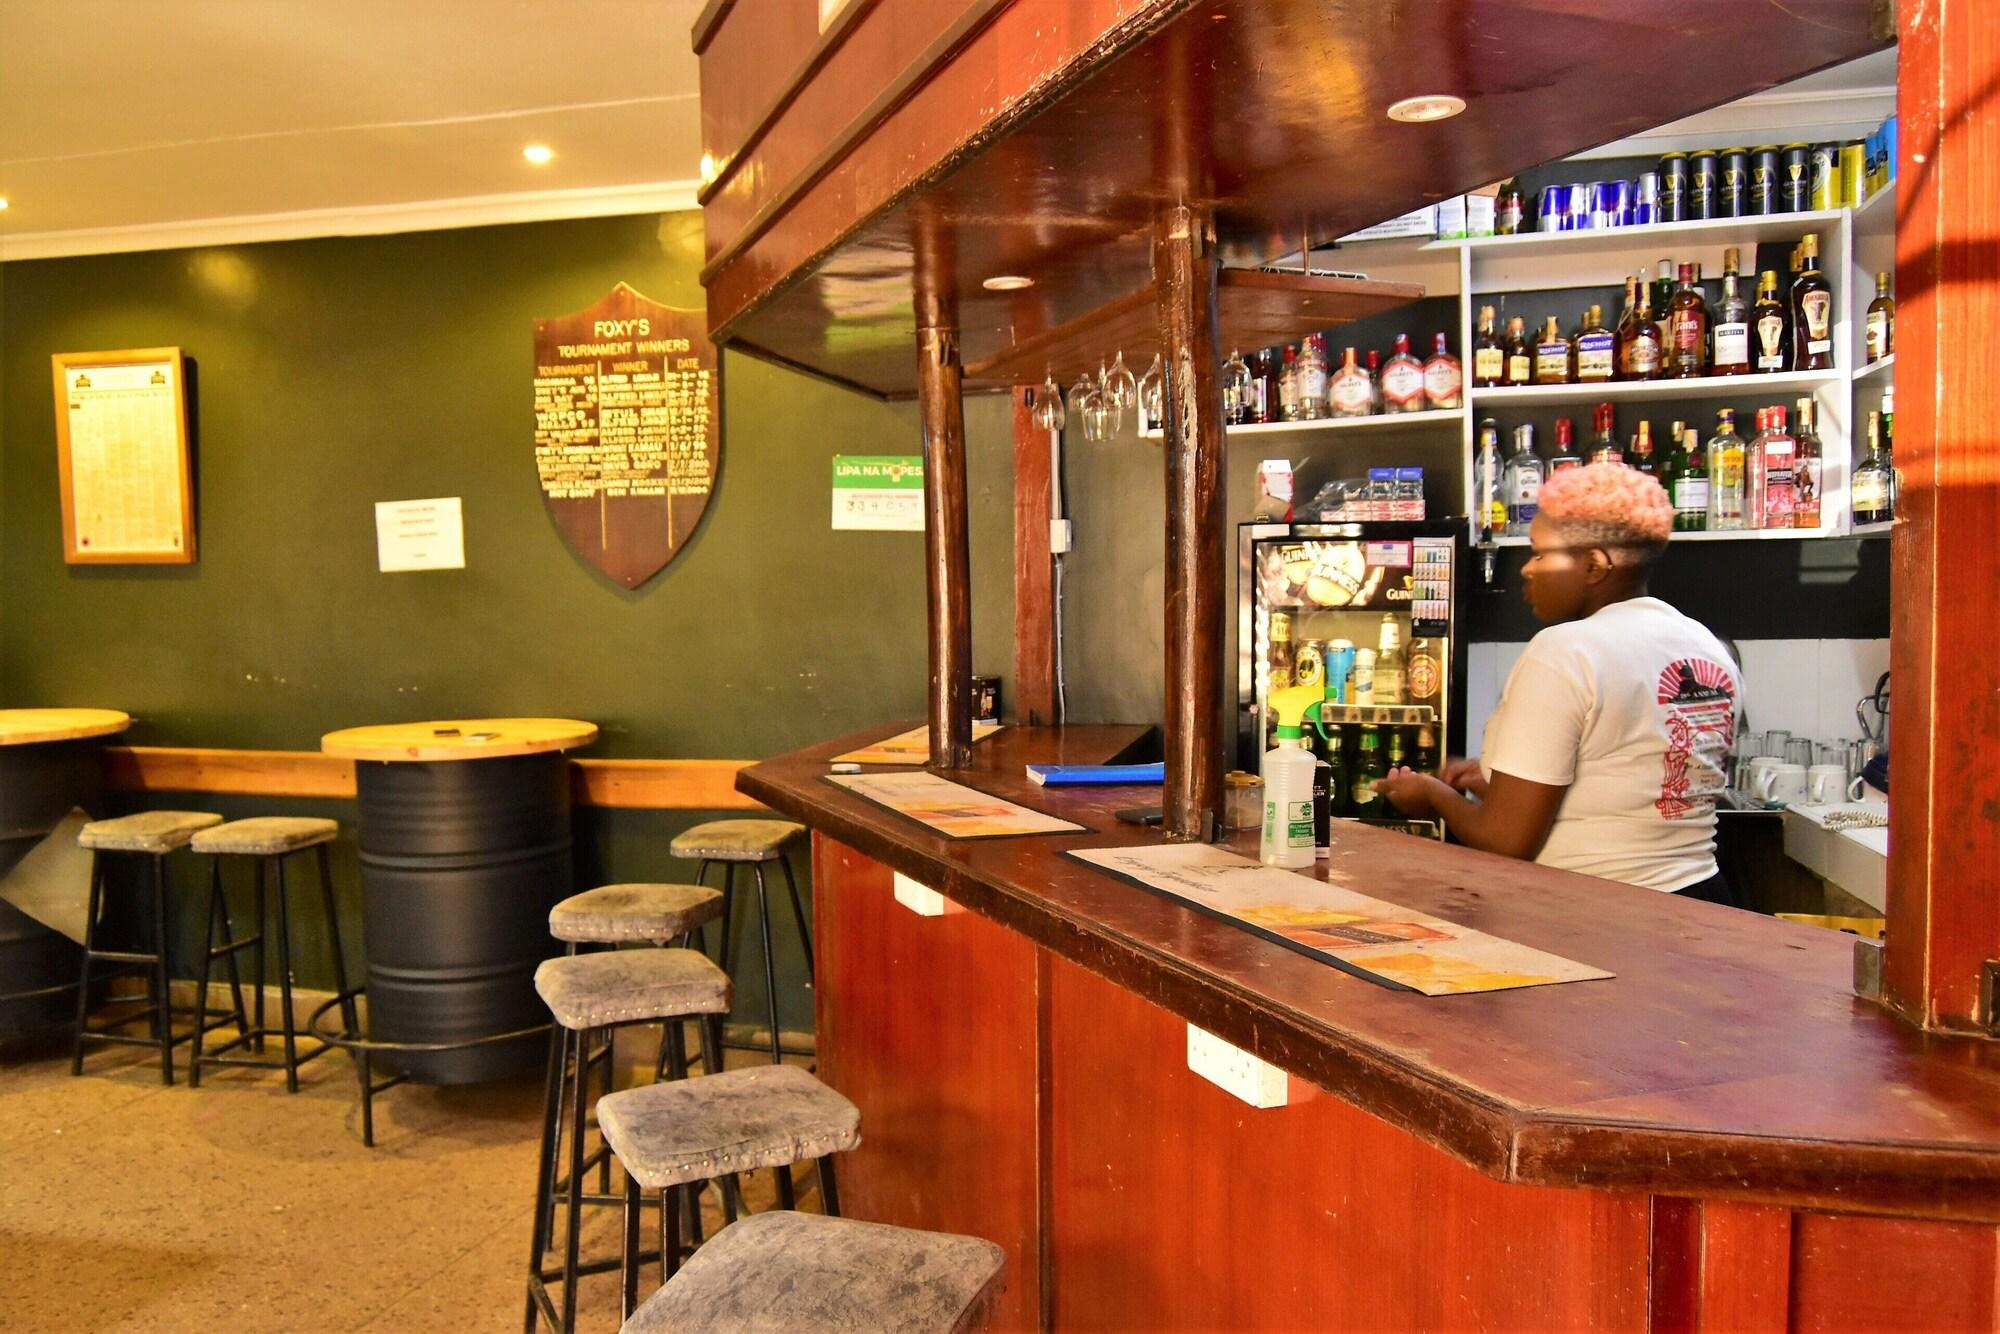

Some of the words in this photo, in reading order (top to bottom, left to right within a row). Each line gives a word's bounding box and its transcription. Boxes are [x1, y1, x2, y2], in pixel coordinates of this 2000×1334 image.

[594, 319, 650, 337] FOXY'S
[558, 342, 632, 357] TOURNAMENT
[636, 339, 690, 353] WINNERS
[538, 364, 595, 377] TOURNAMENT
[612, 361, 648, 373] WINNER
[677, 358, 700, 370] DATE
[601, 428, 635, 436] ALFRED
[628, 442, 662, 452] KAMAU
[837, 465, 861, 476] LIPA
[863, 465, 880, 476] NA
